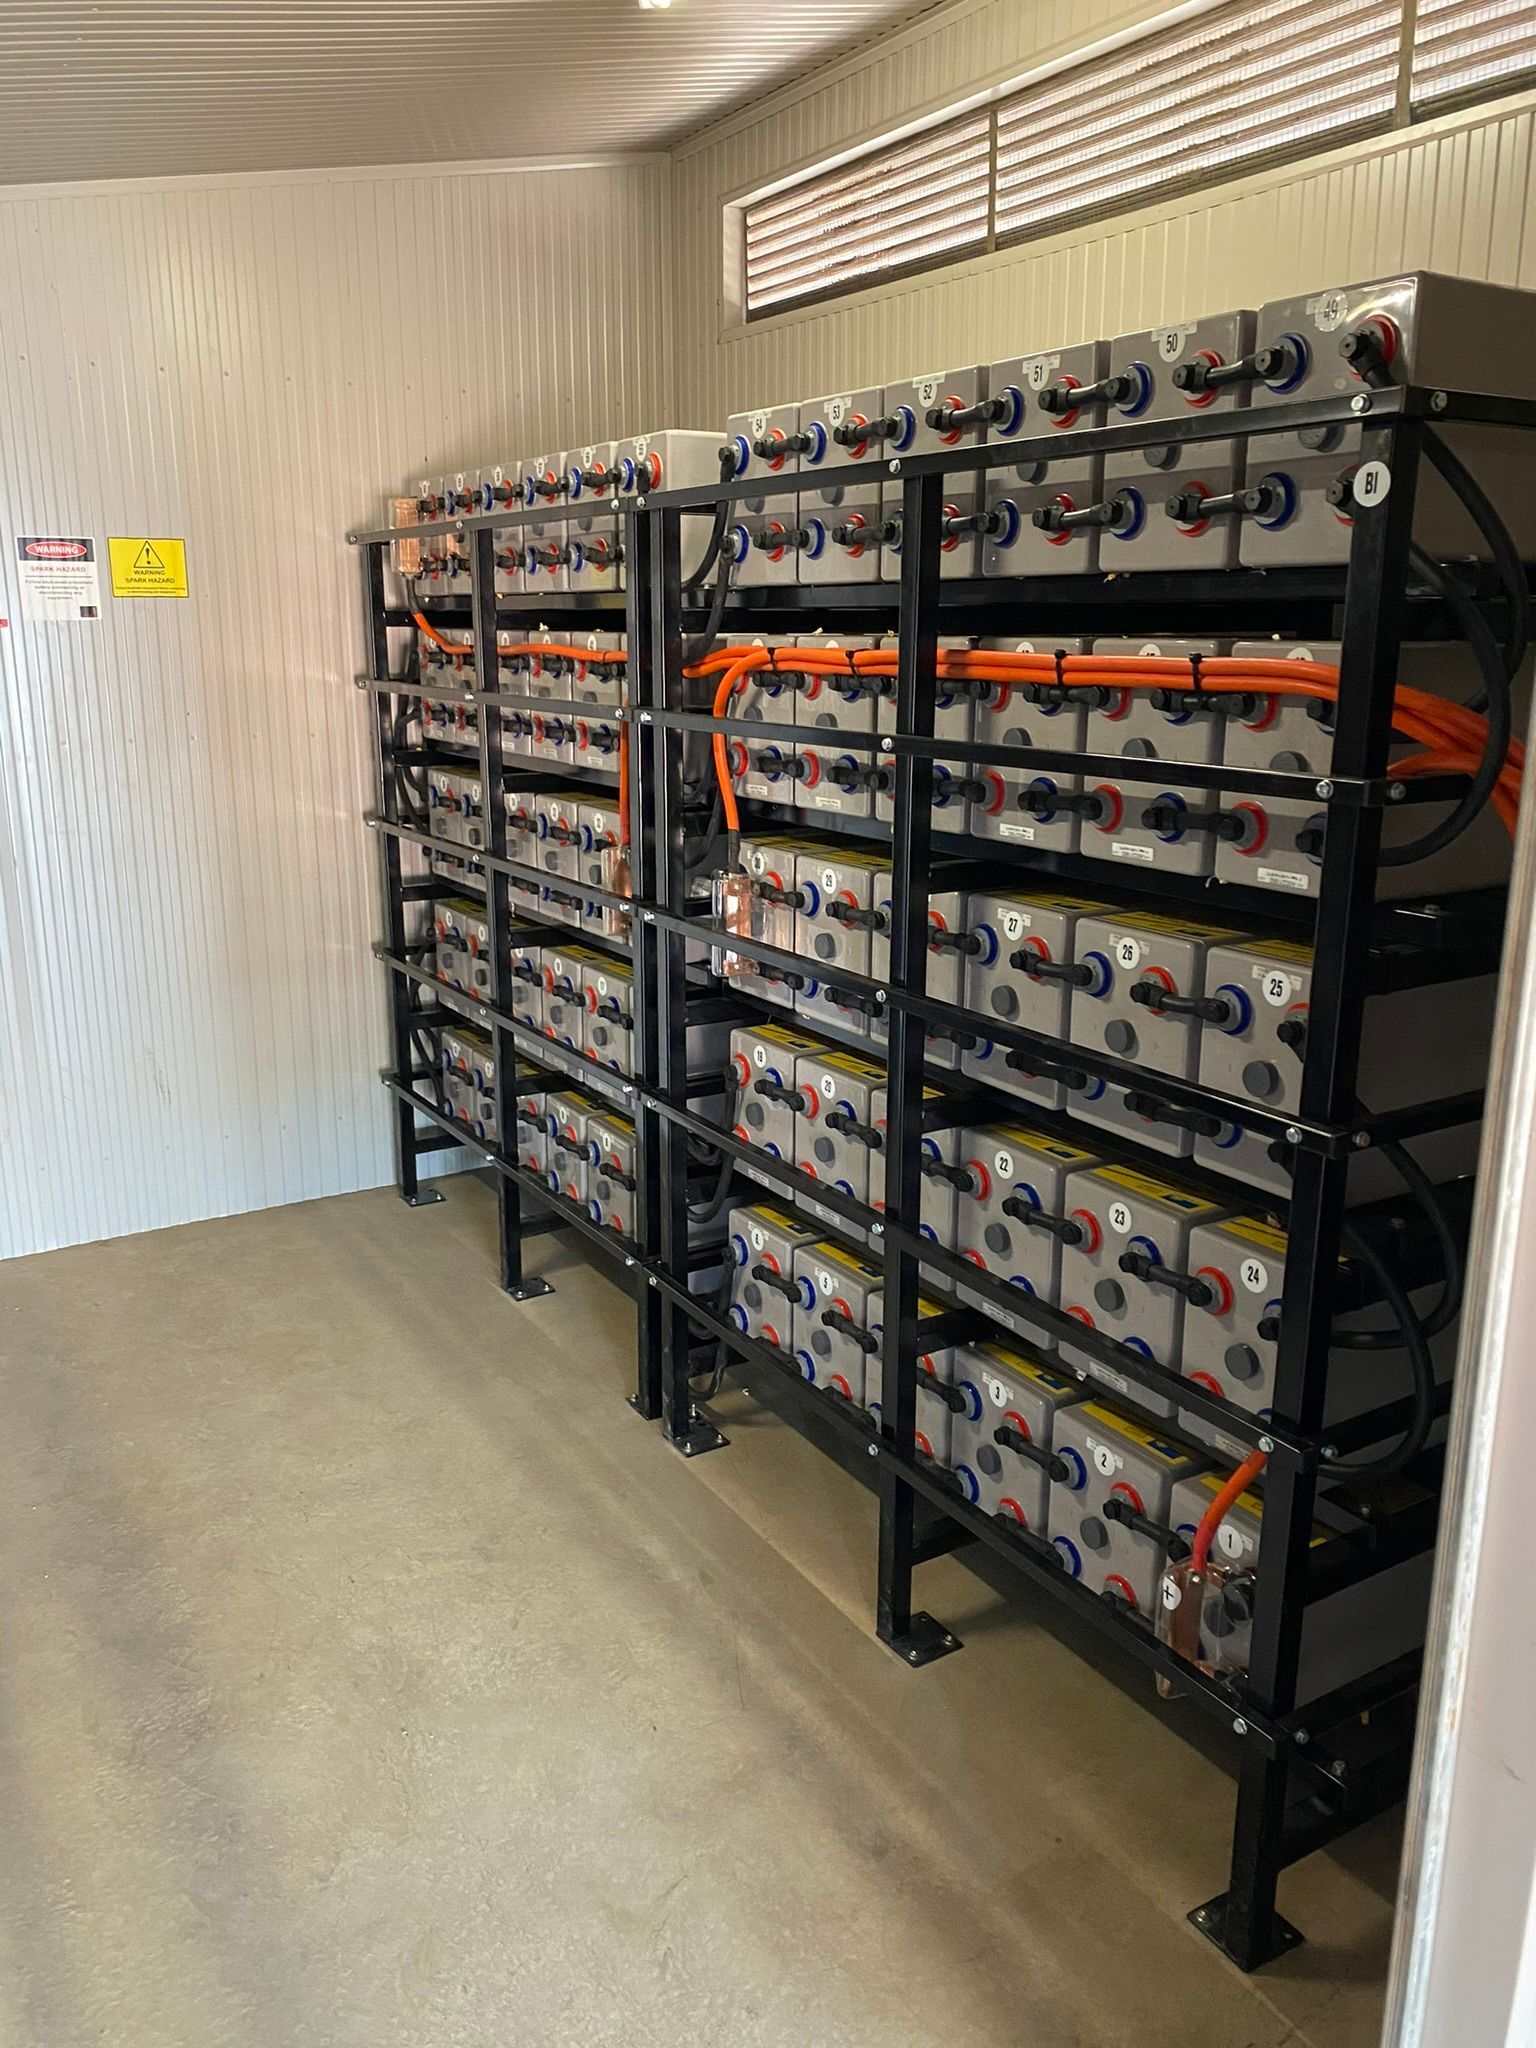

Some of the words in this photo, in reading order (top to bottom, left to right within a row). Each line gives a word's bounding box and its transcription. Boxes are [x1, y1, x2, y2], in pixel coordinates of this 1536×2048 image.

[1324, 300, 1338, 321] 49
[1166, 333, 1178, 353] 50
[1033, 364, 1043, 383] 51
[923, 383, 933, 400] 52
[35, 545, 79, 554] WARNING
[1008, 917, 1018, 933] 27
[1122, 944, 1134, 961] 26
[1269, 978, 1283, 997] 25
[999, 1157, 1009, 1172] 22
[1114, 1209, 1125, 1226] 23
[1247, 1265, 1260, 1284] 24
[995, 1386, 1001, 1400] 3
[1101, 1453, 1107, 1469] 2
